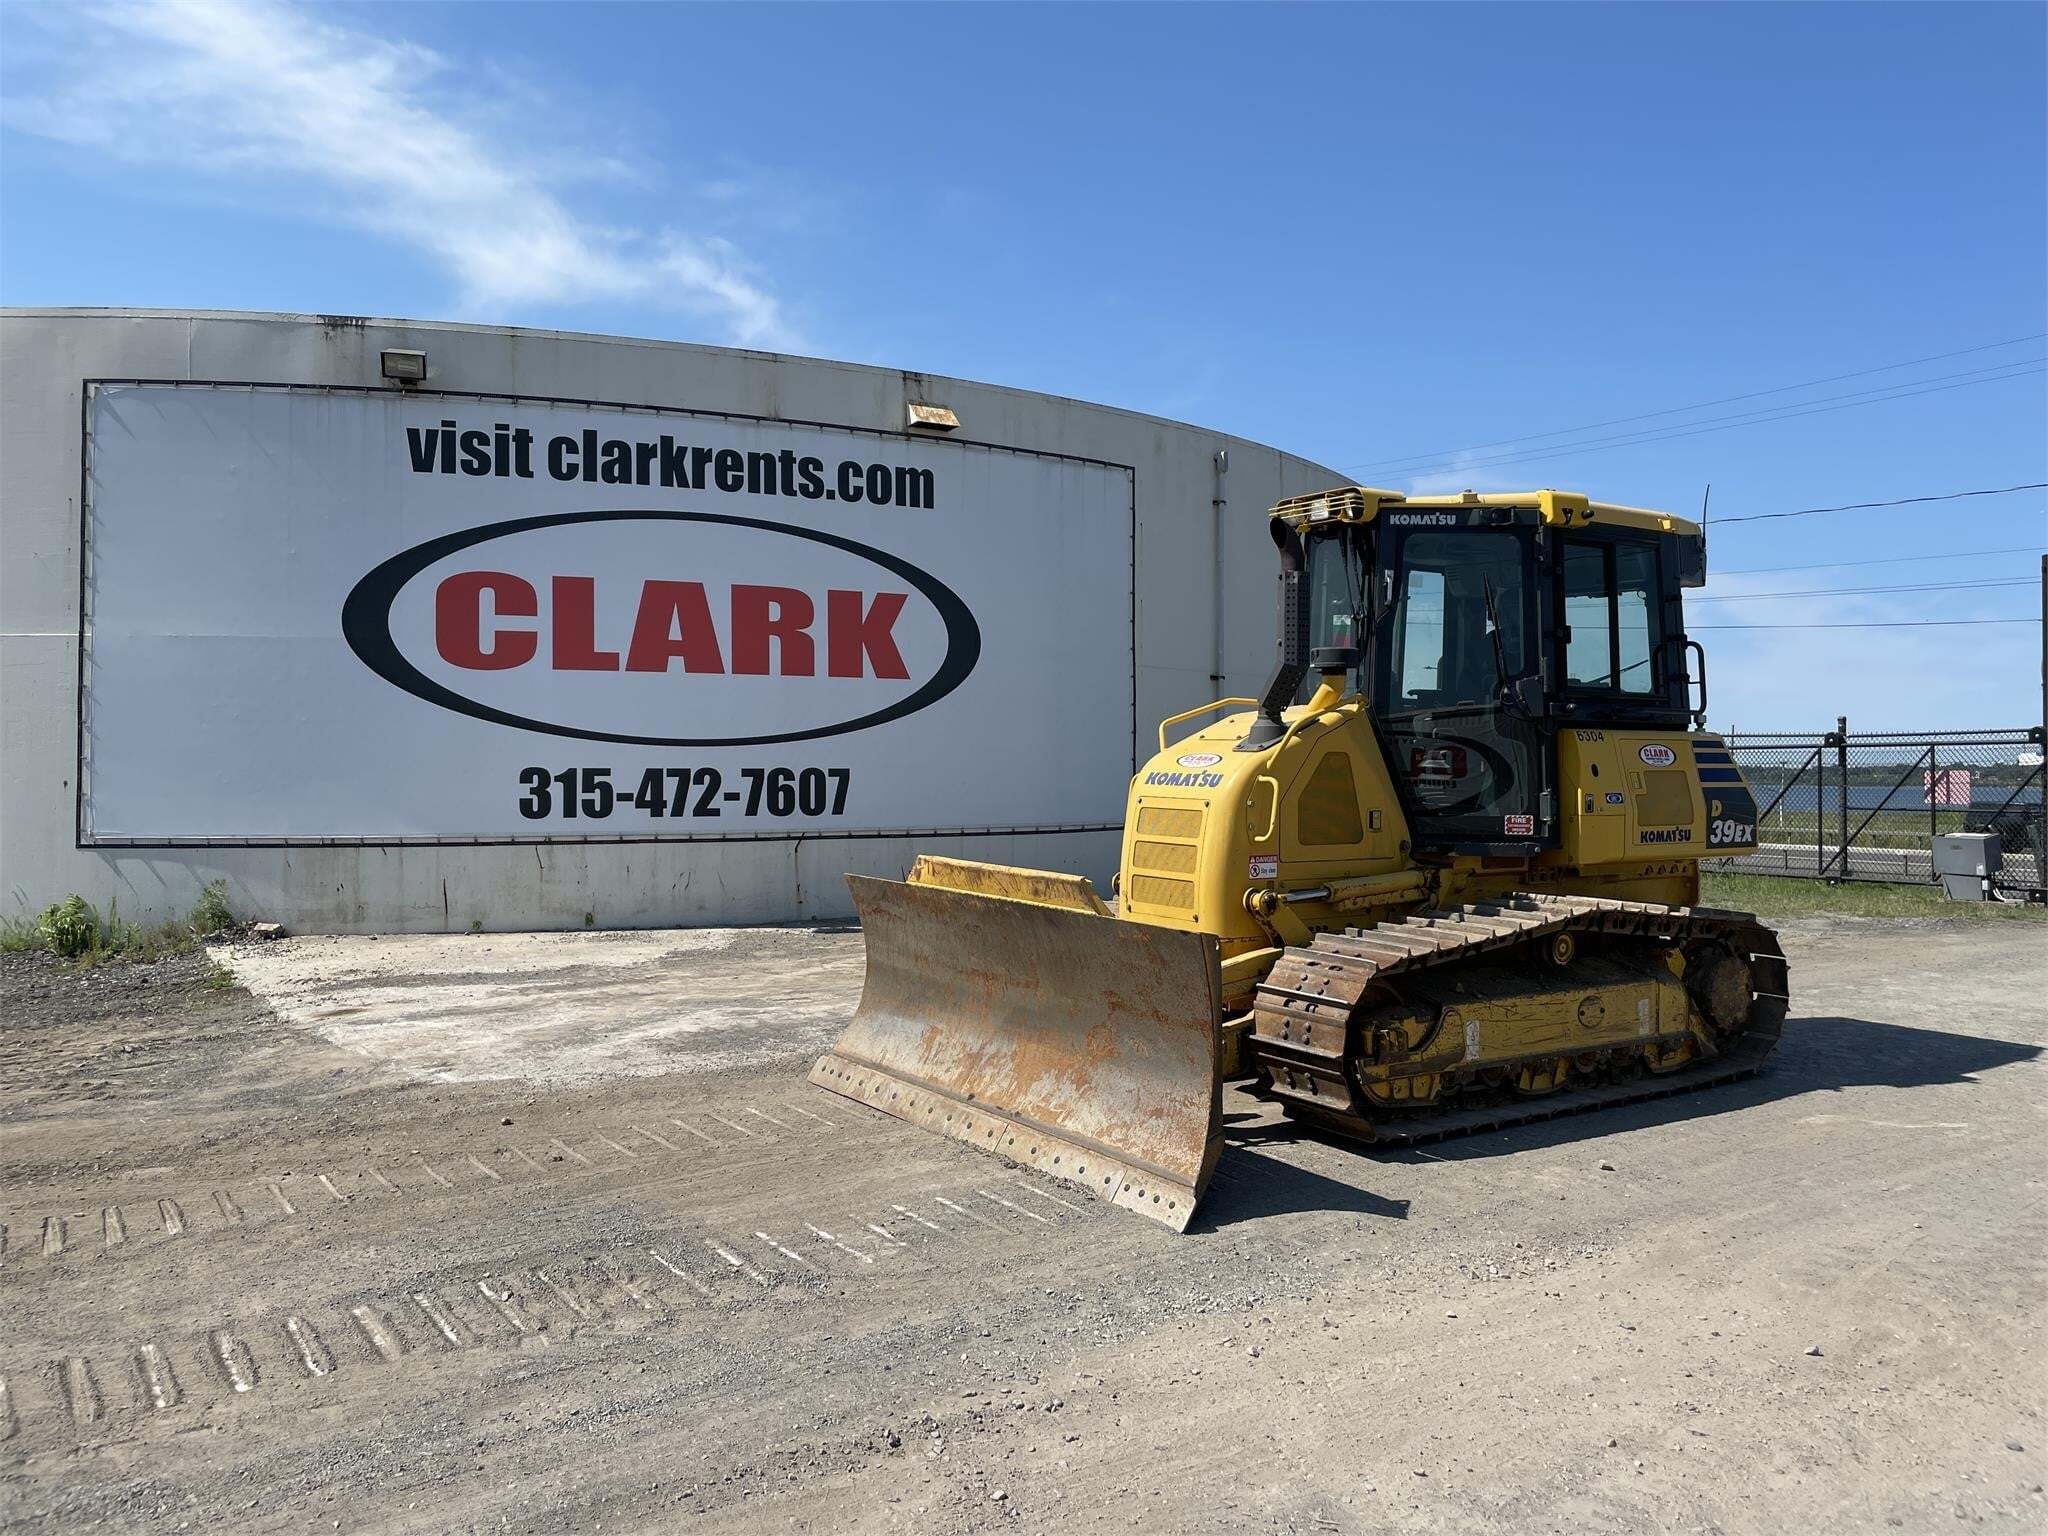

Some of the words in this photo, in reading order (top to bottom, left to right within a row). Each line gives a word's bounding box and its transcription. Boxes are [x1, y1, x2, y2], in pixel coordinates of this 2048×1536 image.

[407, 420, 534, 479] visit
[548, 430, 935, 509] clarkrents.com
[1390, 512, 1456, 525] KOMATSU
[435, 571, 911, 680] CLARK
[1577, 730, 1605, 742] 6304
[1145, 770, 1224, 788] KOMATSU
[519, 766, 850, 819] 315-472-7607
[1711, 800, 1722, 816] D
[1640, 826, 1691, 844] KOMATSU
[1710, 820, 1753, 843] 39EX
